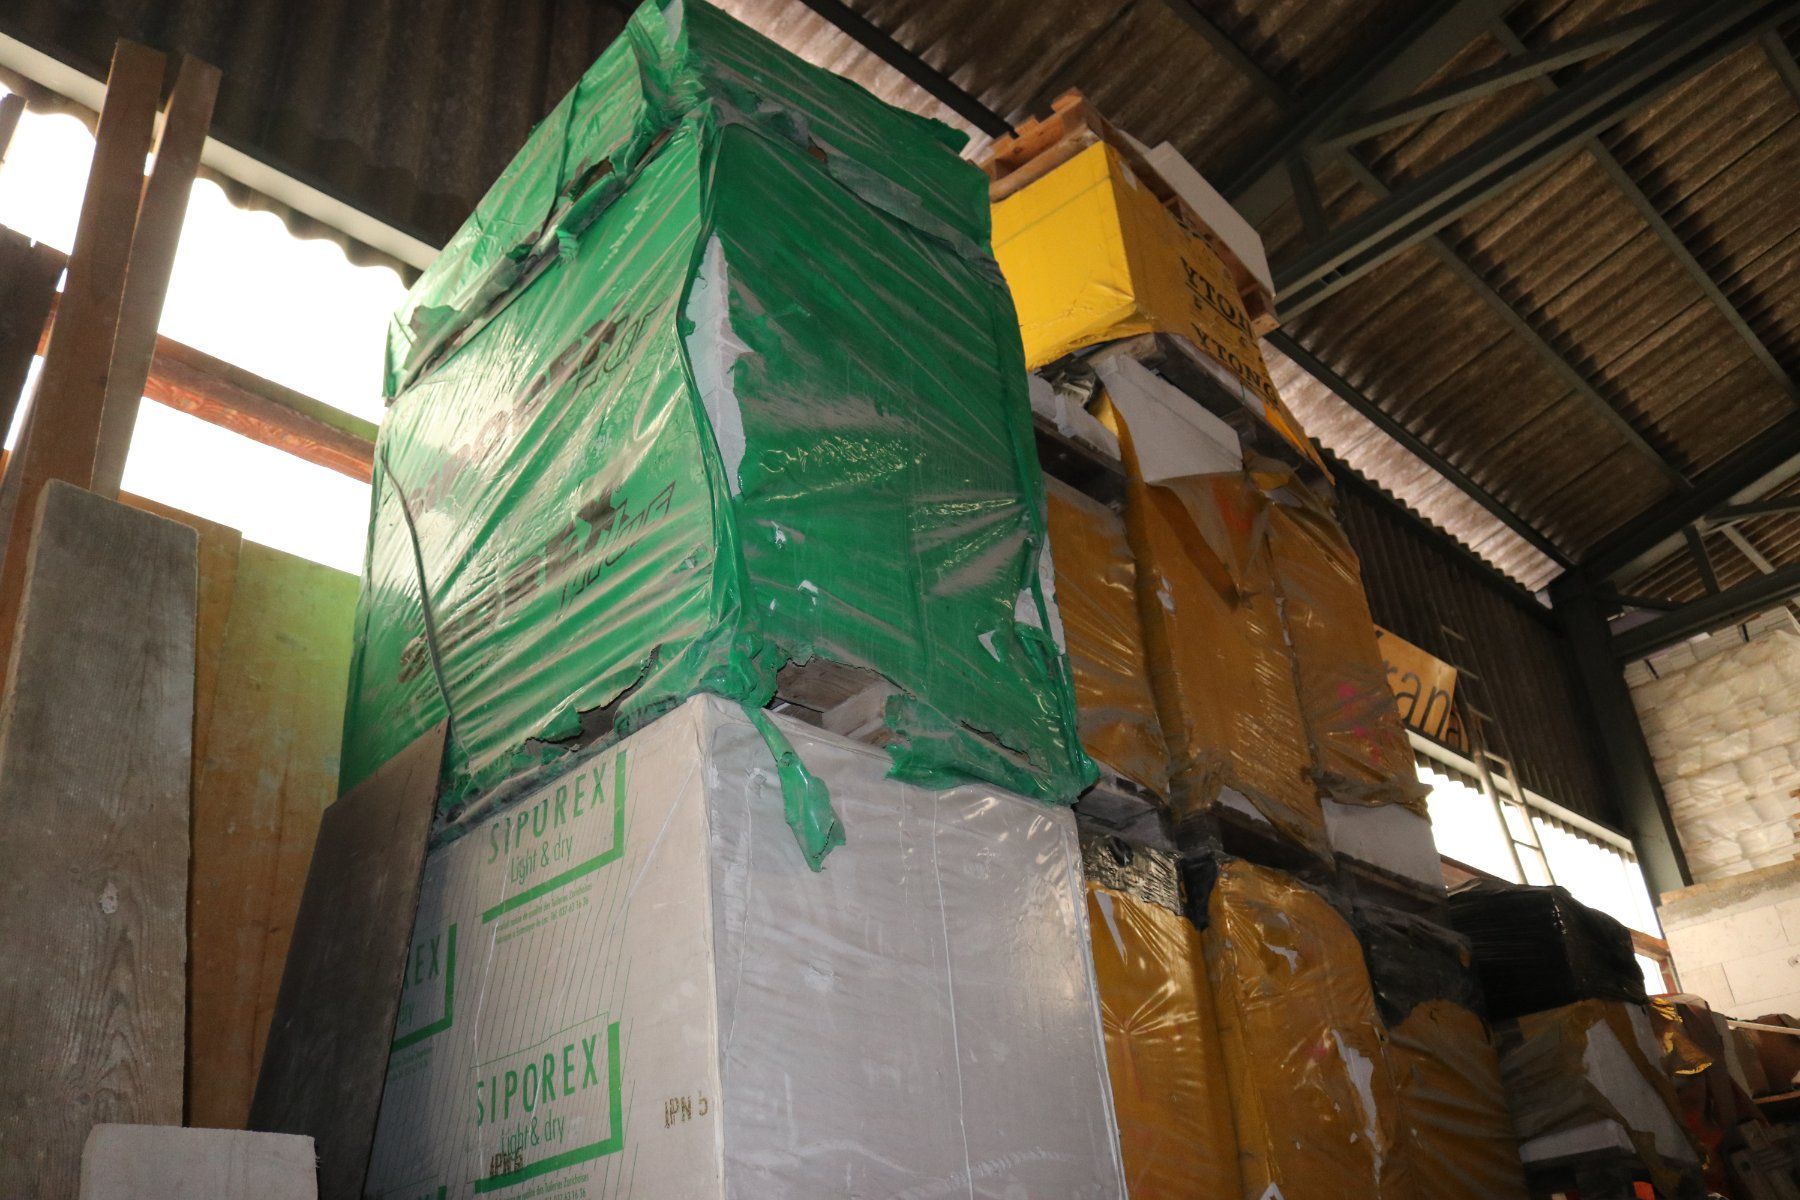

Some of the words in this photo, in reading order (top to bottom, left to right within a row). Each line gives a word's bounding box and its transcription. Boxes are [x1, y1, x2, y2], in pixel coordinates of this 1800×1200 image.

[1191, 322, 1281, 411] YTONG
[511, 850, 537, 885] Light
[541, 840, 550, 868] &
[554, 831, 573, 862] dry
[477, 1034, 600, 1127] SIPOREX
[500, 1122, 529, 1160] Light
[530, 1116, 540, 1147] &
[544, 1110, 565, 1144] dry
